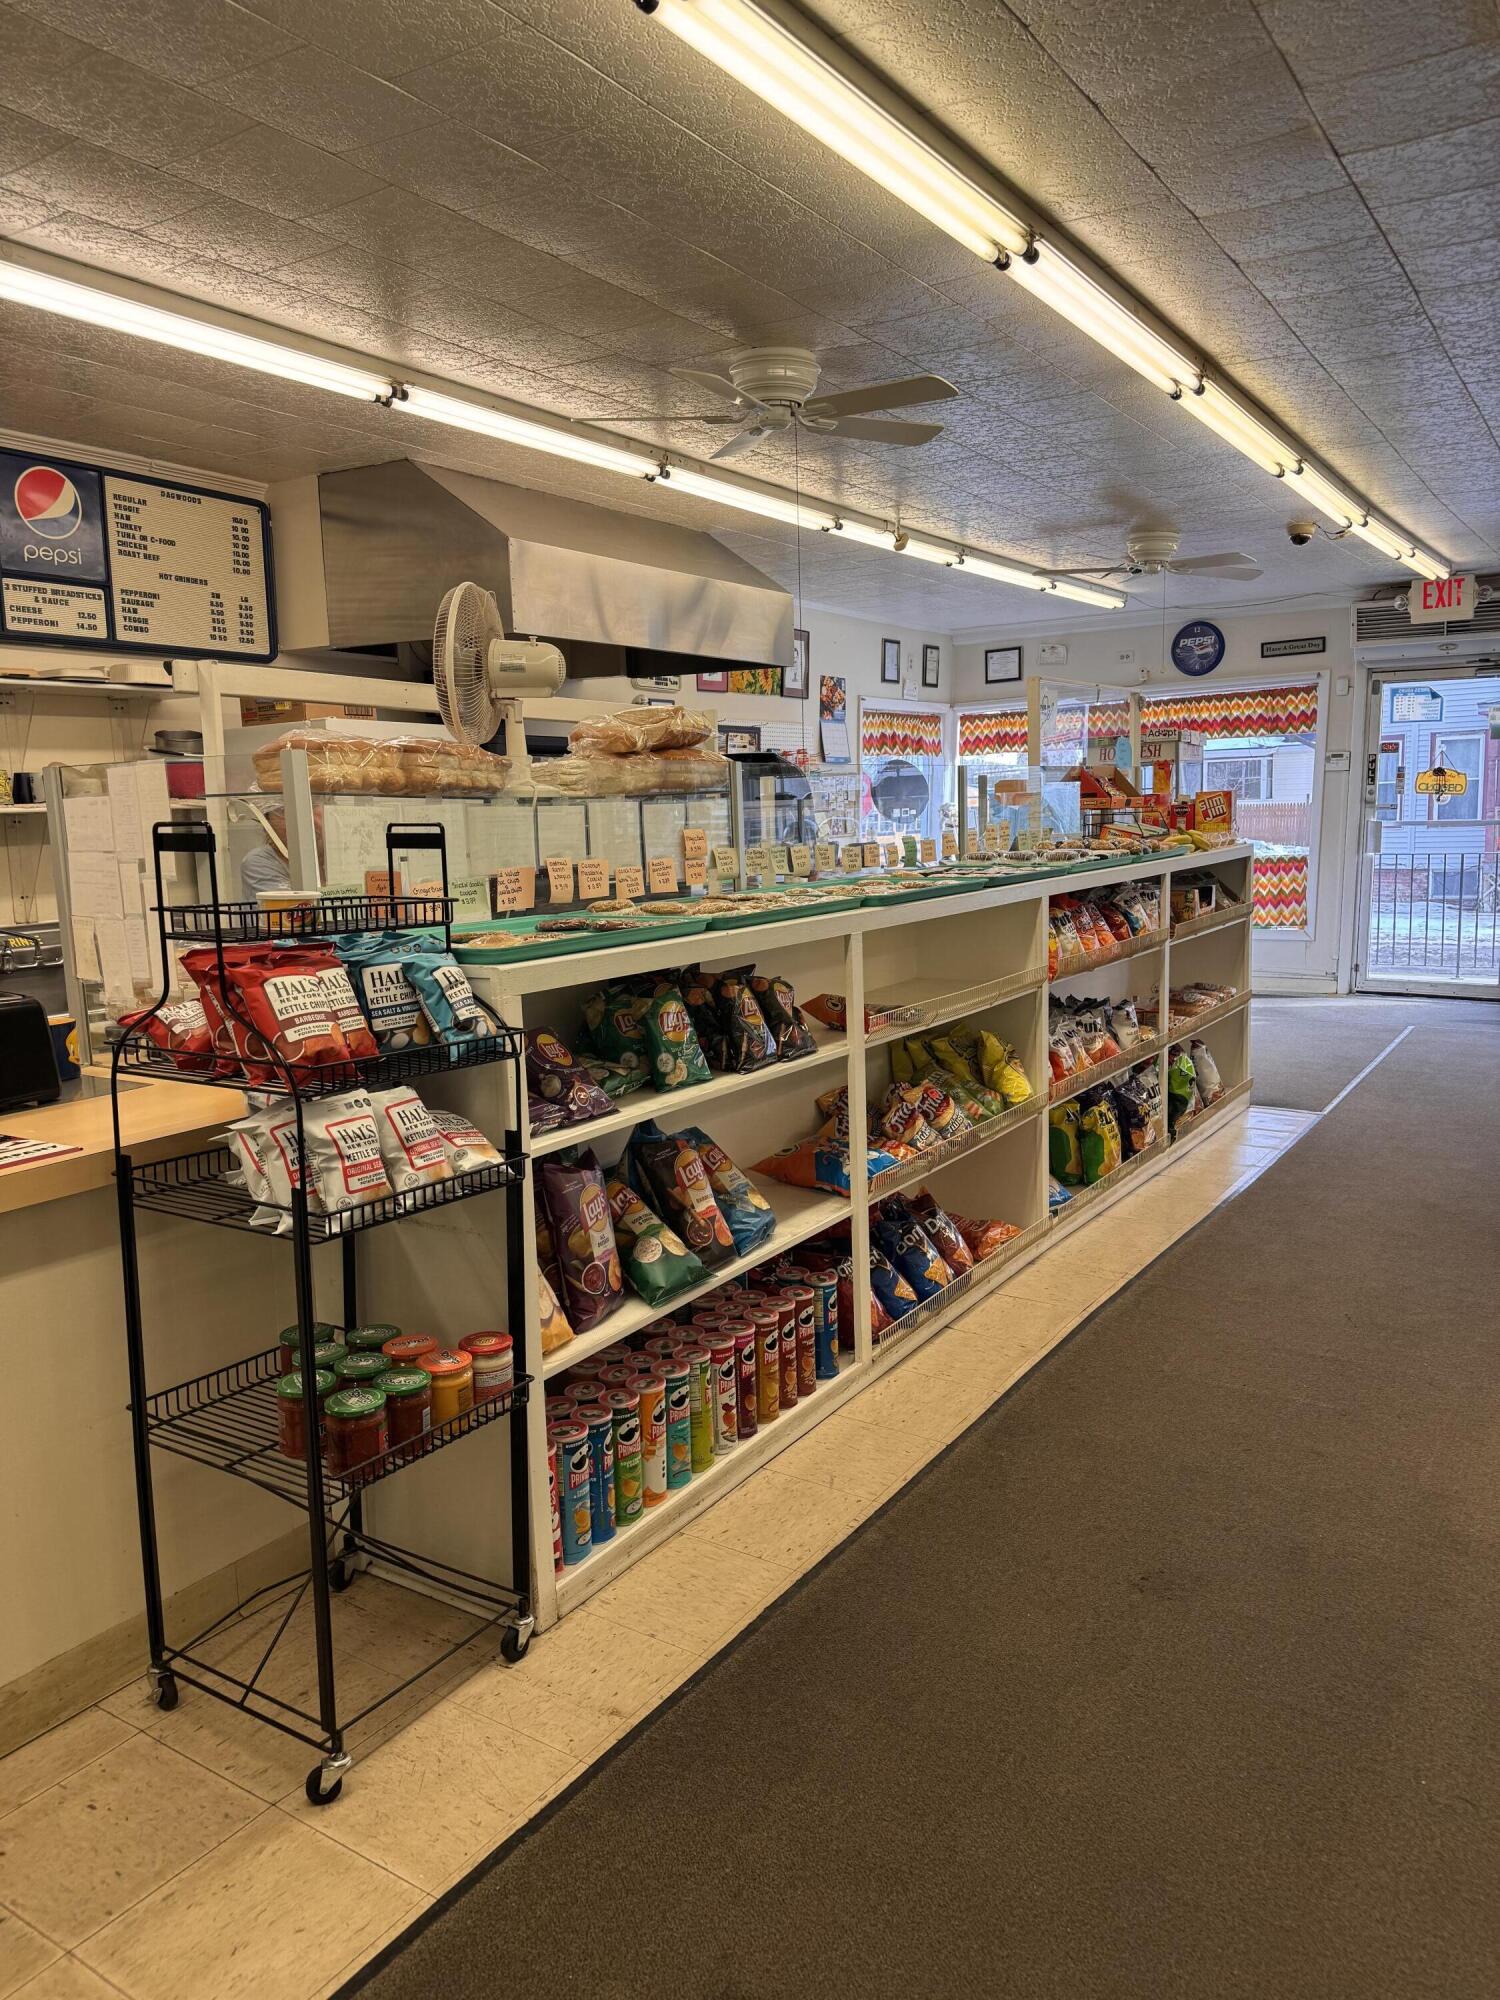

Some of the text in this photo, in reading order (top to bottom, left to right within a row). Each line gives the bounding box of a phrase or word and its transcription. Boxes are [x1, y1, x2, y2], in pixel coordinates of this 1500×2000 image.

[113, 493, 147, 506] REGULAR
[160, 490, 202, 505] DAGWOODS
[113, 502, 140, 514] VEGGIE
[114, 512, 131, 521] HAM
[115, 521, 142, 532] TURKEY
[116, 530, 176, 547] TUNA OR C-FOOD
[117, 540, 148, 551] CHICKEN
[24, 544, 82, 566] pepsi
[118, 549, 160, 561] ROAST BEEF
[158, 572, 208, 586] HOT GRINDERS
[12, 584, 48, 595] STUFFED
[50, 588, 102, 600] BREADSTICKS
[120, 588, 160, 600] PEPPERONI
[1423, 578, 1465, 610] EXIT
[42, 596, 70, 606] SAUCE
[121, 598, 155, 608] SAUSAGE
[10, 604, 96, 620] CHEESE 12.50
[122, 606, 138, 614] HAM
[10, 616, 98, 631] PEPPERONI 14.50
[122, 616, 149, 624] VEGGIE
[124, 624, 149, 633] COMBO
[1179, 635, 1215, 648] PEPSI
[1308, 642, 1321, 650] Day
[1368, 754, 1376, 785] PULL
[272, 978, 320, 998] HAL'S
[280, 992, 321, 1004] NEW YORK
[370, 994, 398, 1006] KETTLE
[278, 1000, 328, 1016] KETTLE CHIP
[372, 1010, 382, 1018] SEA
[397, 1106, 430, 1126] HAL'S
[337, 1124, 376, 1145] HAL'S
[405, 1124, 419, 1132] NEW
[404, 1130, 426, 1144] KETTLE
[346, 1150, 372, 1162] KETTLE
[702, 1146, 726, 1171] Lay's
[346, 1164, 372, 1176] ORIGINAL
[679, 1155, 704, 1188] Lay's
[582, 1191, 606, 1227] Lay's
